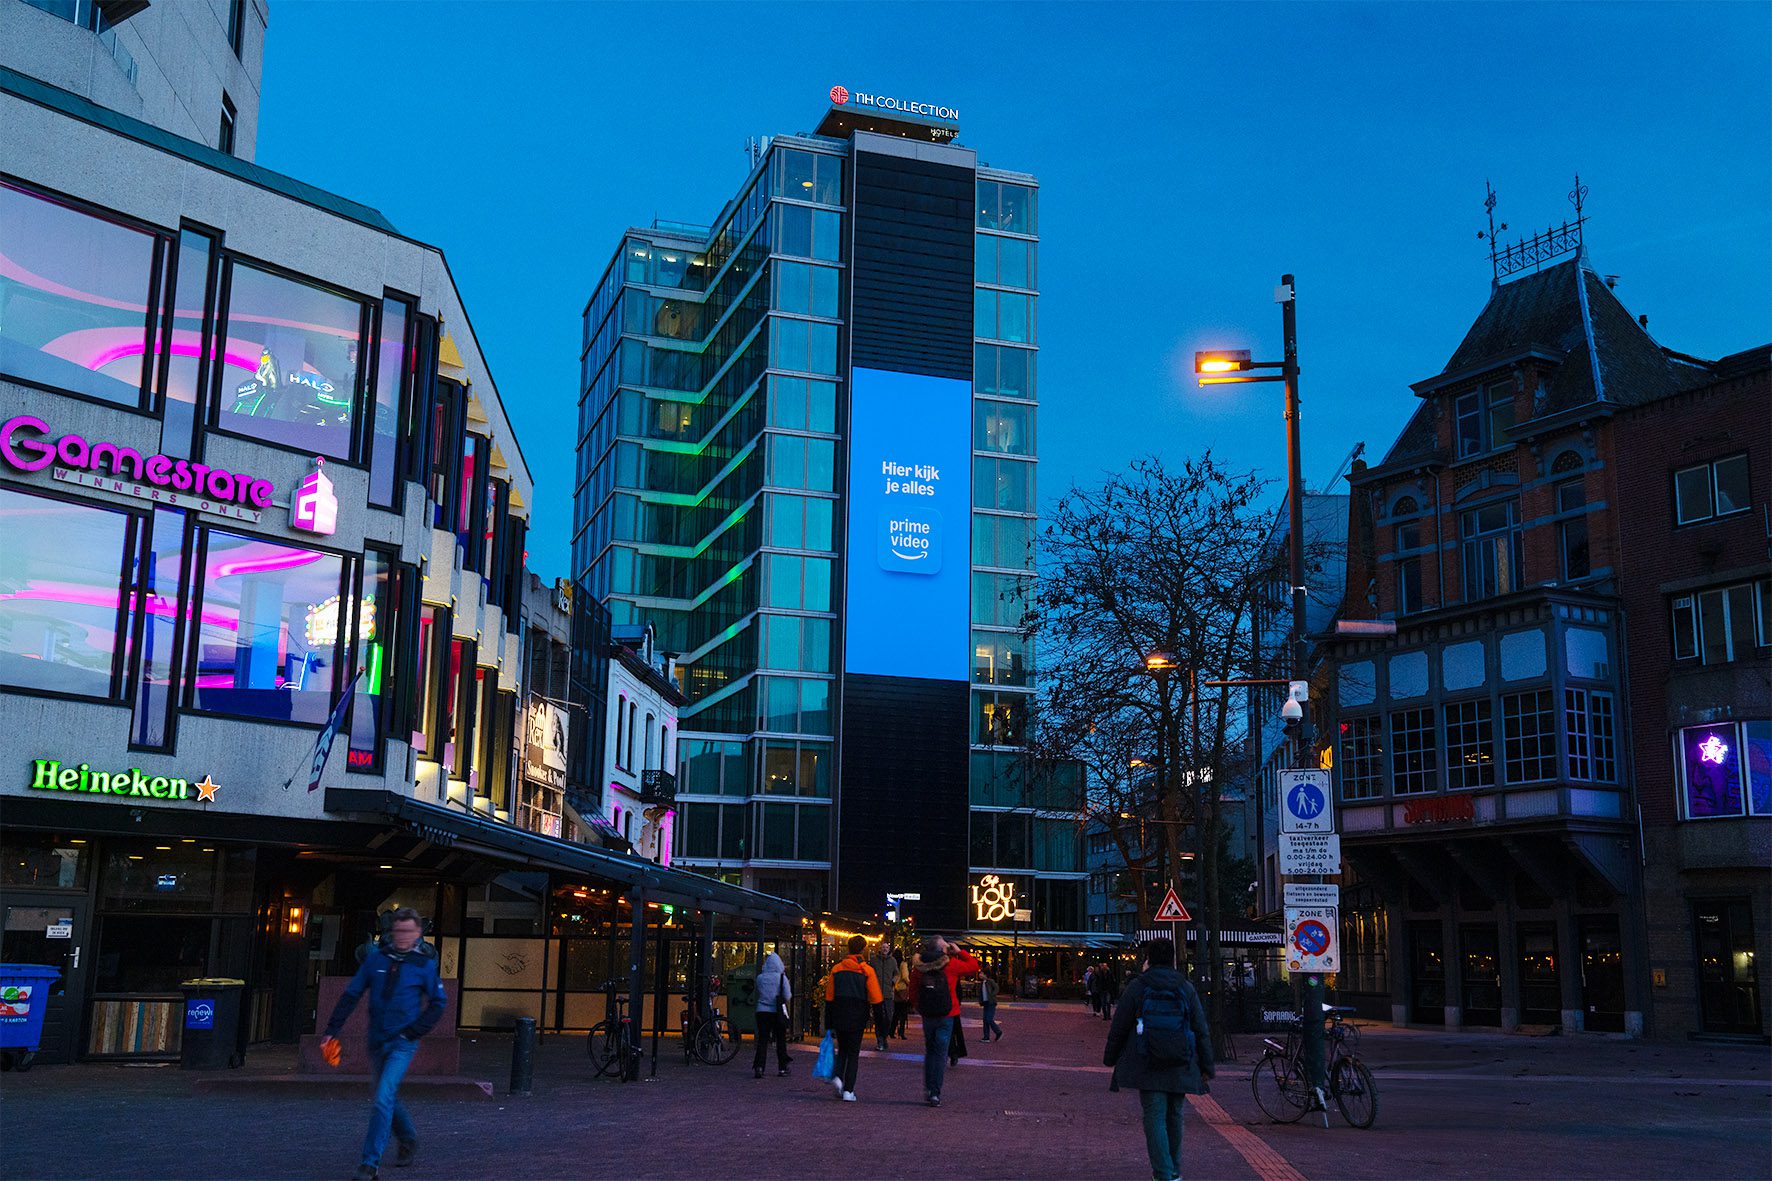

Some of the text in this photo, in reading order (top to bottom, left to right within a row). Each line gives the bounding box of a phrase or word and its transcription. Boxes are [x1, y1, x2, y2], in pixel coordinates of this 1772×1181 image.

[876, 96, 959, 120] COLLECTION
[930, 128, 959, 138] HOTELS
[238, 382, 258, 394] HALO
[289, 373, 335, 393] HALO
[882, 461, 940, 482] Hier kijk
[55, 468, 260, 521] WINNERS ONLY
[885, 478, 935, 496] je alles
[890, 518, 930, 534] prime
[891, 533, 929, 549] video
[32, 759, 188, 799] Heineken
[547, 768, 554, 784] &
[971, 882, 1014, 905] LOU
[976, 899, 1017, 922] LOU
[1299, 910, 1323, 918] ZONE
[1248, 934, 1278, 942] GAUCHOS
